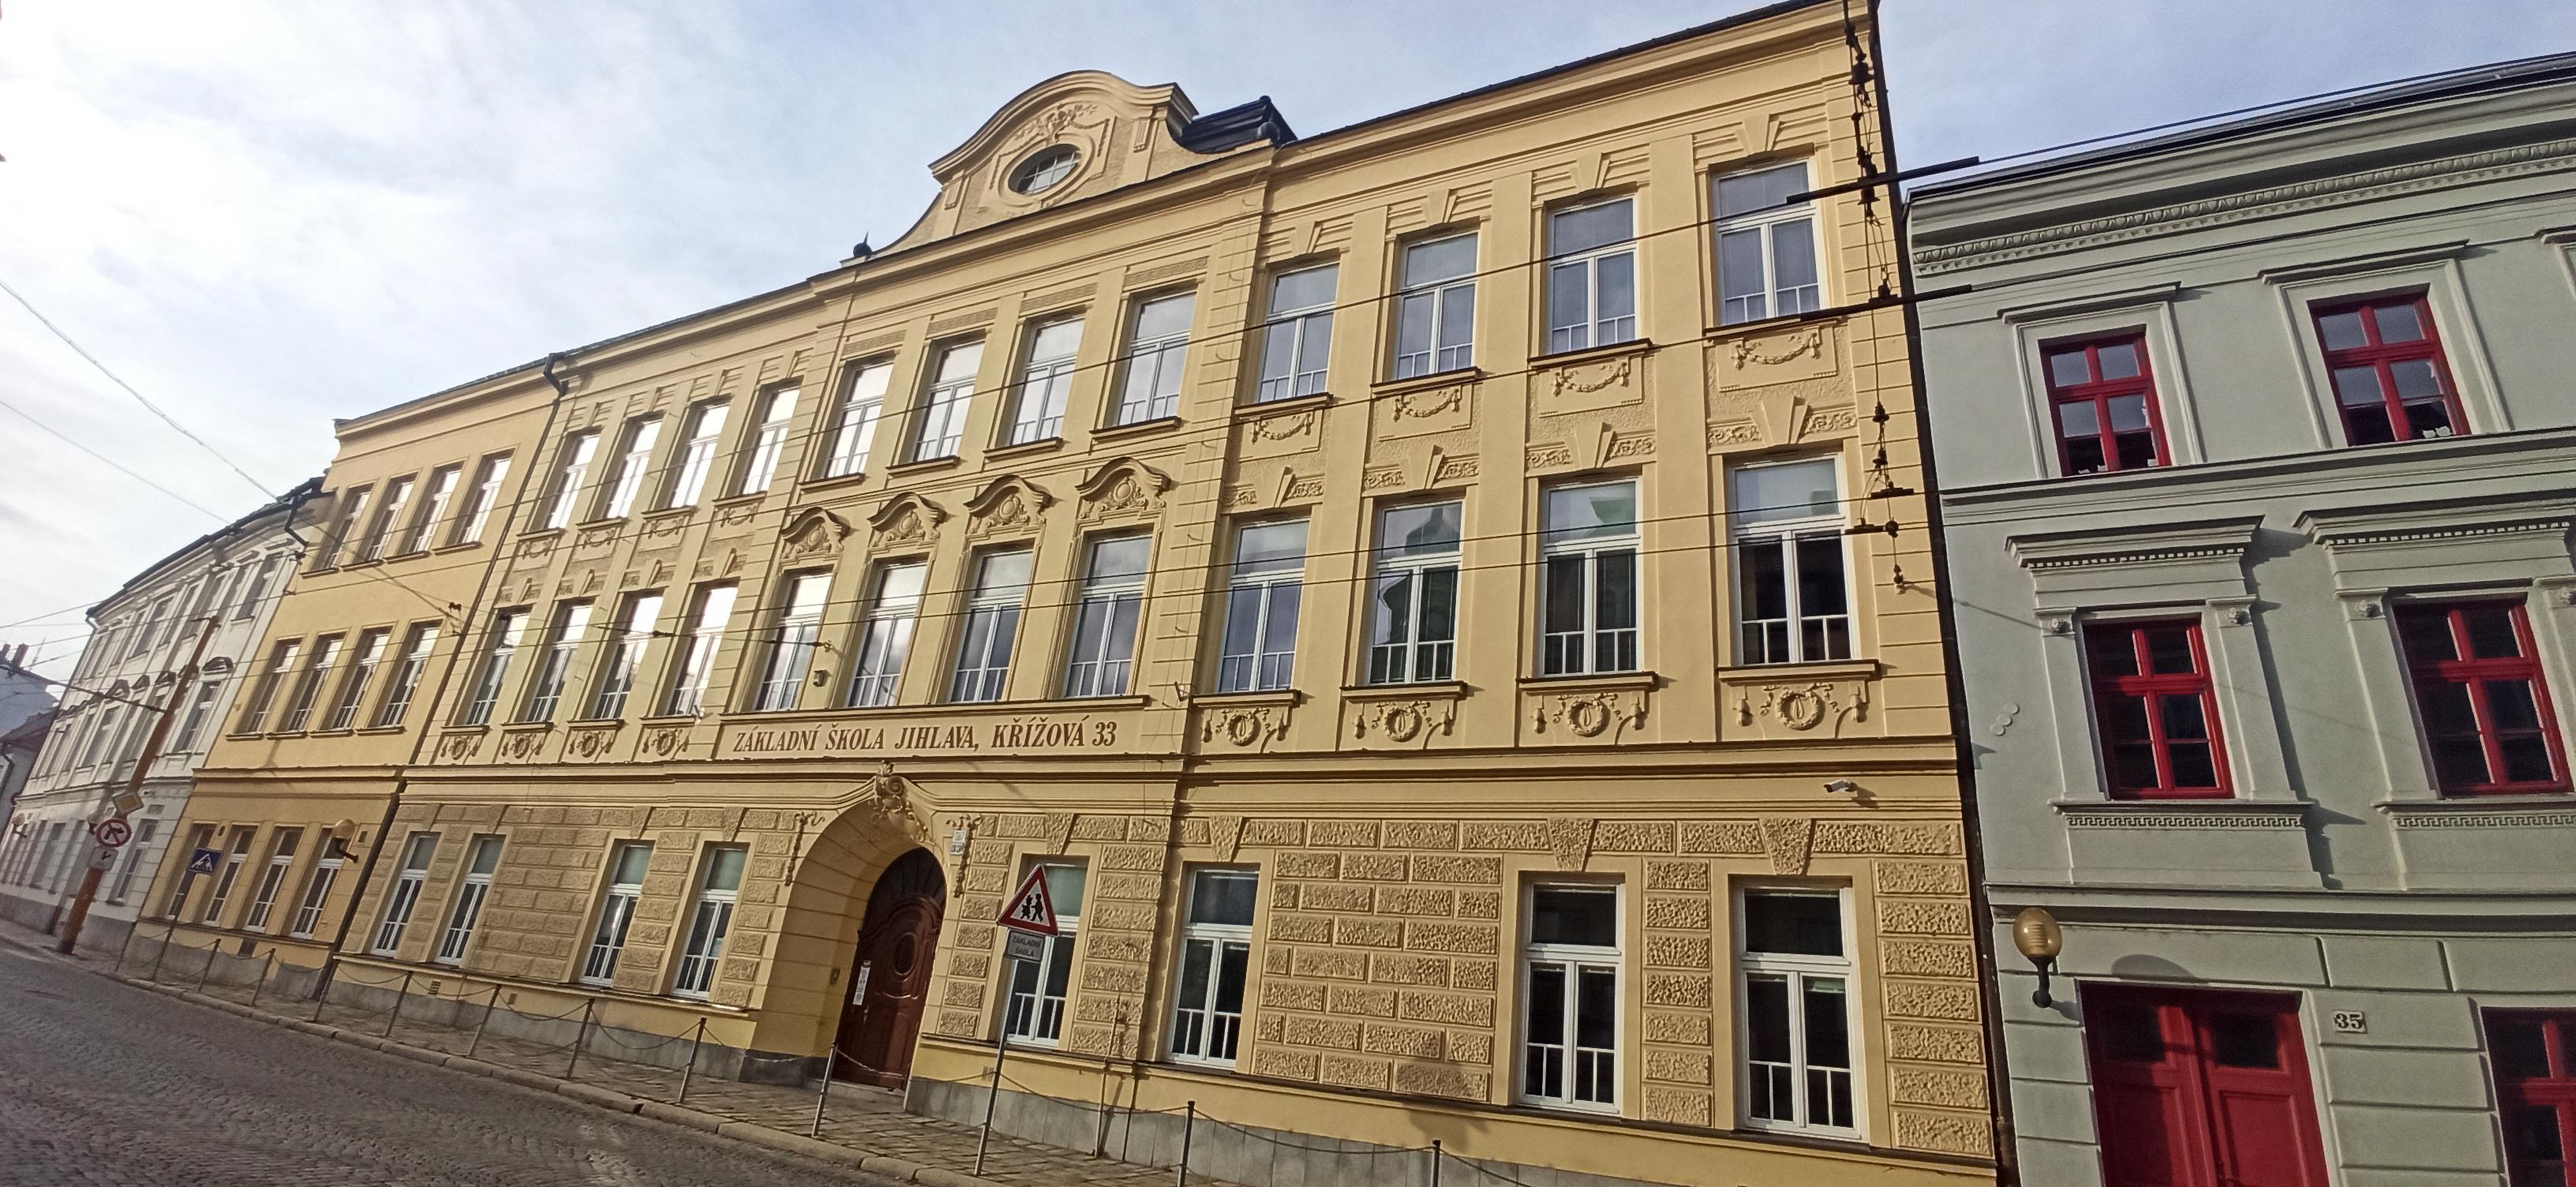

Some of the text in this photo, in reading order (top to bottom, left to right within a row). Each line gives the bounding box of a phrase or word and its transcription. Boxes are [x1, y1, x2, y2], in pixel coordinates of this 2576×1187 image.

[732, 715, 1118, 752] ZÁKLADNÍ ŠKOLA JIHLAVA, KŘÍŽOVÁ 33
[2335, 1013, 2363, 1029] 35
